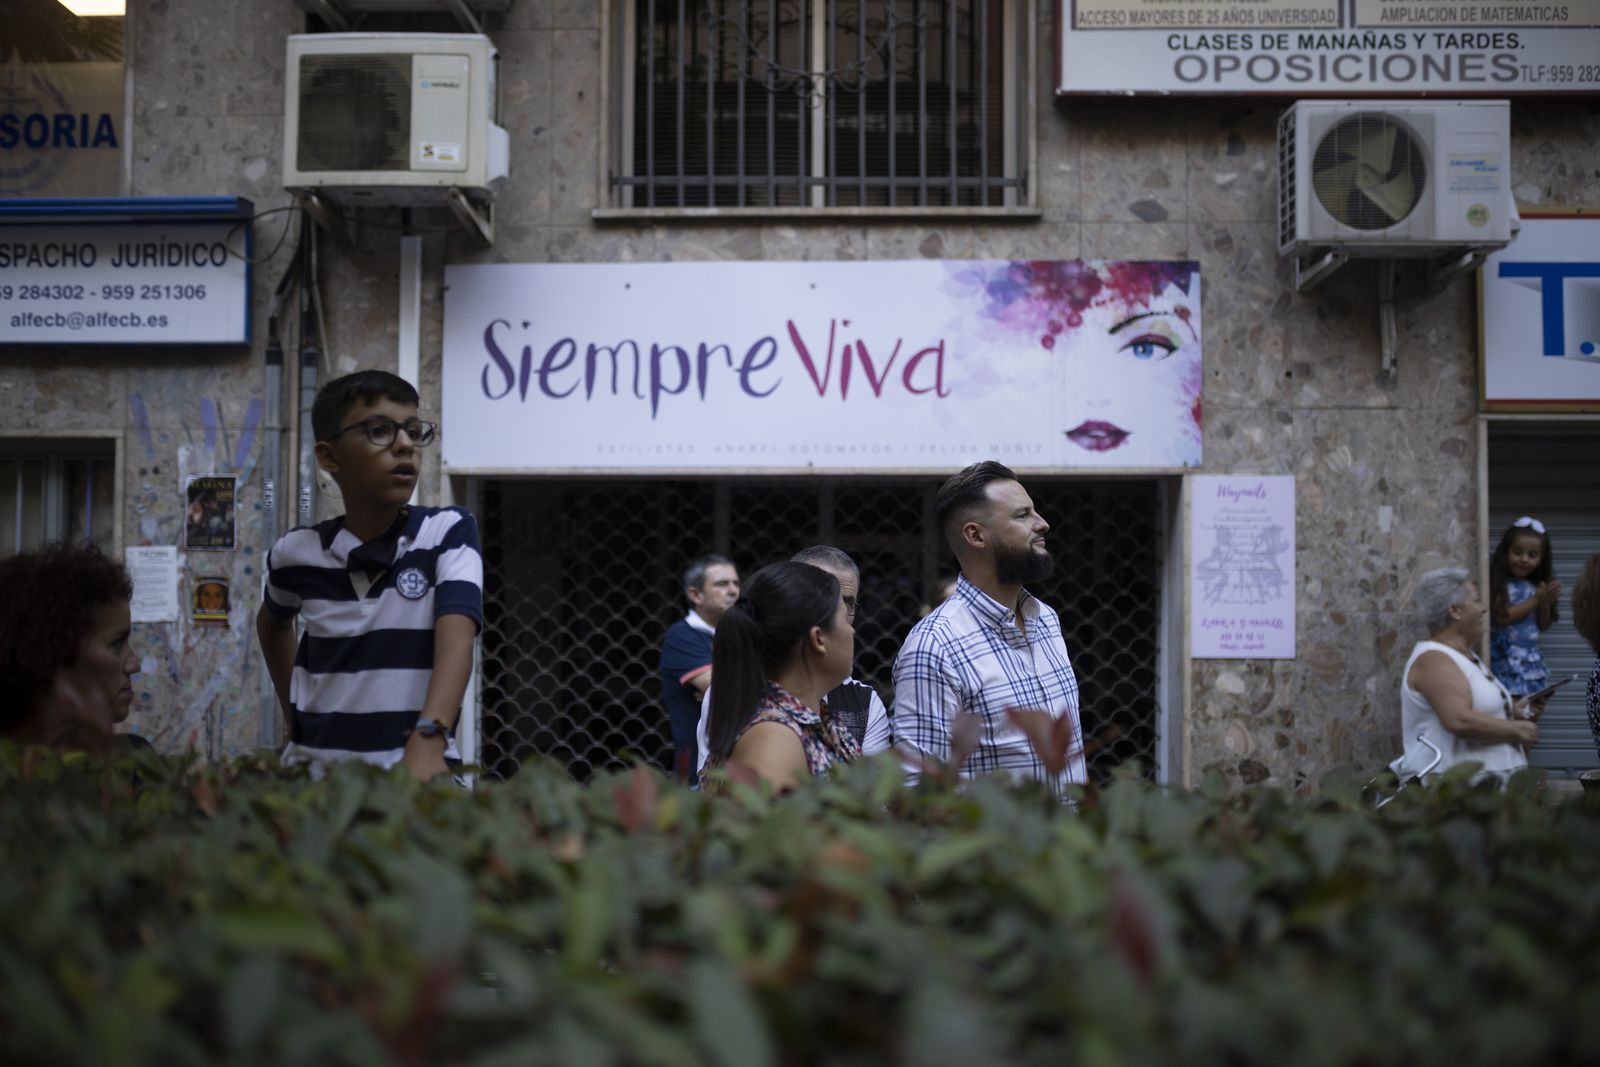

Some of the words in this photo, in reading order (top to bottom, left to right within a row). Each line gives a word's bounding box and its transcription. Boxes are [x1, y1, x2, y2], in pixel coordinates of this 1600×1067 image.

[1078, 10, 1127, 25] ACCESO
[1130, 9, 1186, 25] MAYORES
[1189, 9, 1204, 25] DE
[1207, 9, 1220, 24] 25
[1223, 6, 1256, 24] AÑOS
[1380, 7, 1457, 22] AMPLIACION
[1461, 7, 1477, 22] DE
[1481, 6, 1569, 22] MATEMATICAS
[1167, 34, 1253, 50] CLASES
[1261, 34, 1289, 50] DE
[1299, 30, 1407, 50] MANAÑAS
[1413, 33, 1427, 49] Y
[1433, 32, 1525, 49] TARDES.
[1173, 53, 1520, 83] OPOSICIONES
[0, 113, 118, 149] SORIA
[0, 242, 97, 268] SPACHO
[111, 234, 228, 268] JURÍDICO
[19, 285, 84, 300] 284302
[101, 285, 135, 300] 959
[140, 284, 206, 300] 251306
[10, 311, 169, 330] alfecb@alfecb.es
[597, 443, 696, 454] ESTILISTAS
[790, 443, 892, 454] SOTOMAYOR
